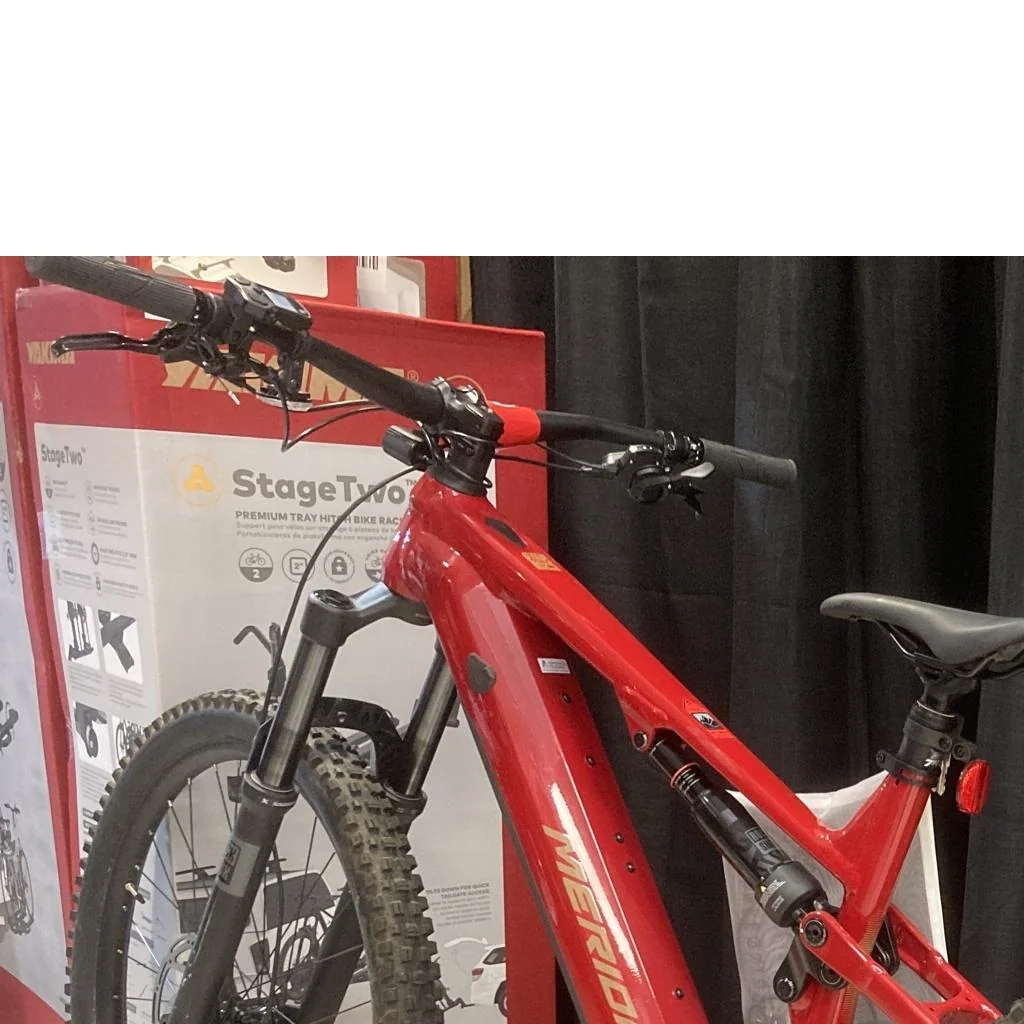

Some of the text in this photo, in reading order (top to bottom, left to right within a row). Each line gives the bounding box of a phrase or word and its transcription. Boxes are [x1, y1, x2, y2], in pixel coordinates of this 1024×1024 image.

[232, 468, 406, 508] StageTwo
[235, 511, 400, 526] PREMIUM TRAY HITH BIKE RAC
[252, 569, 260, 579] 2
